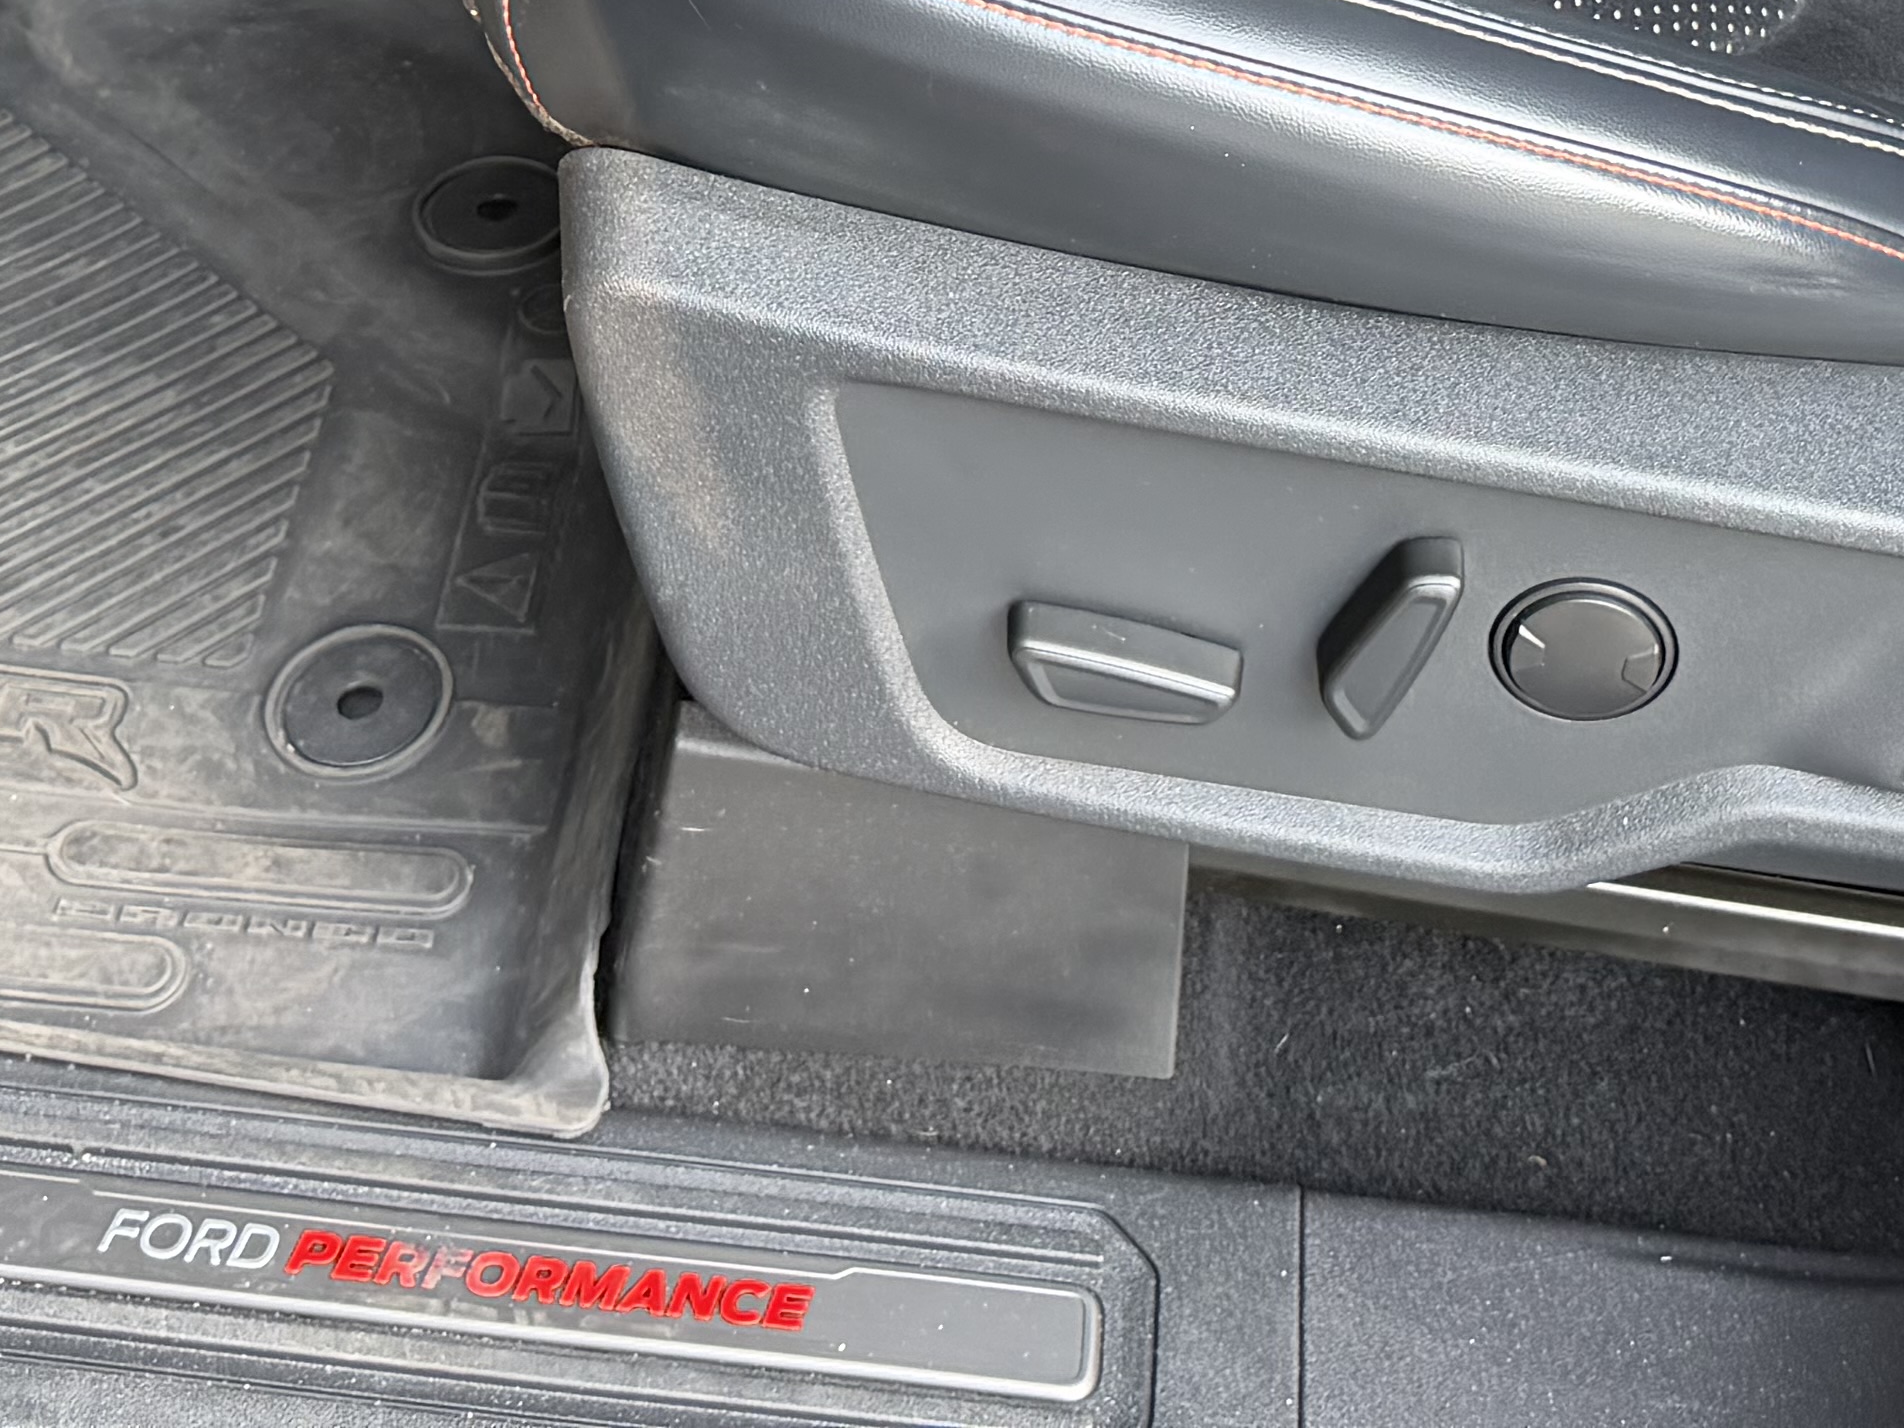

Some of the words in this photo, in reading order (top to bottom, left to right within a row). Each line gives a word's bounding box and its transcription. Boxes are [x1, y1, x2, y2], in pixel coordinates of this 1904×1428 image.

[53, 896, 436, 949] BRONCO
[97, 1203, 280, 1272] FORD
[284, 1227, 816, 1333] PERFORMANCE
